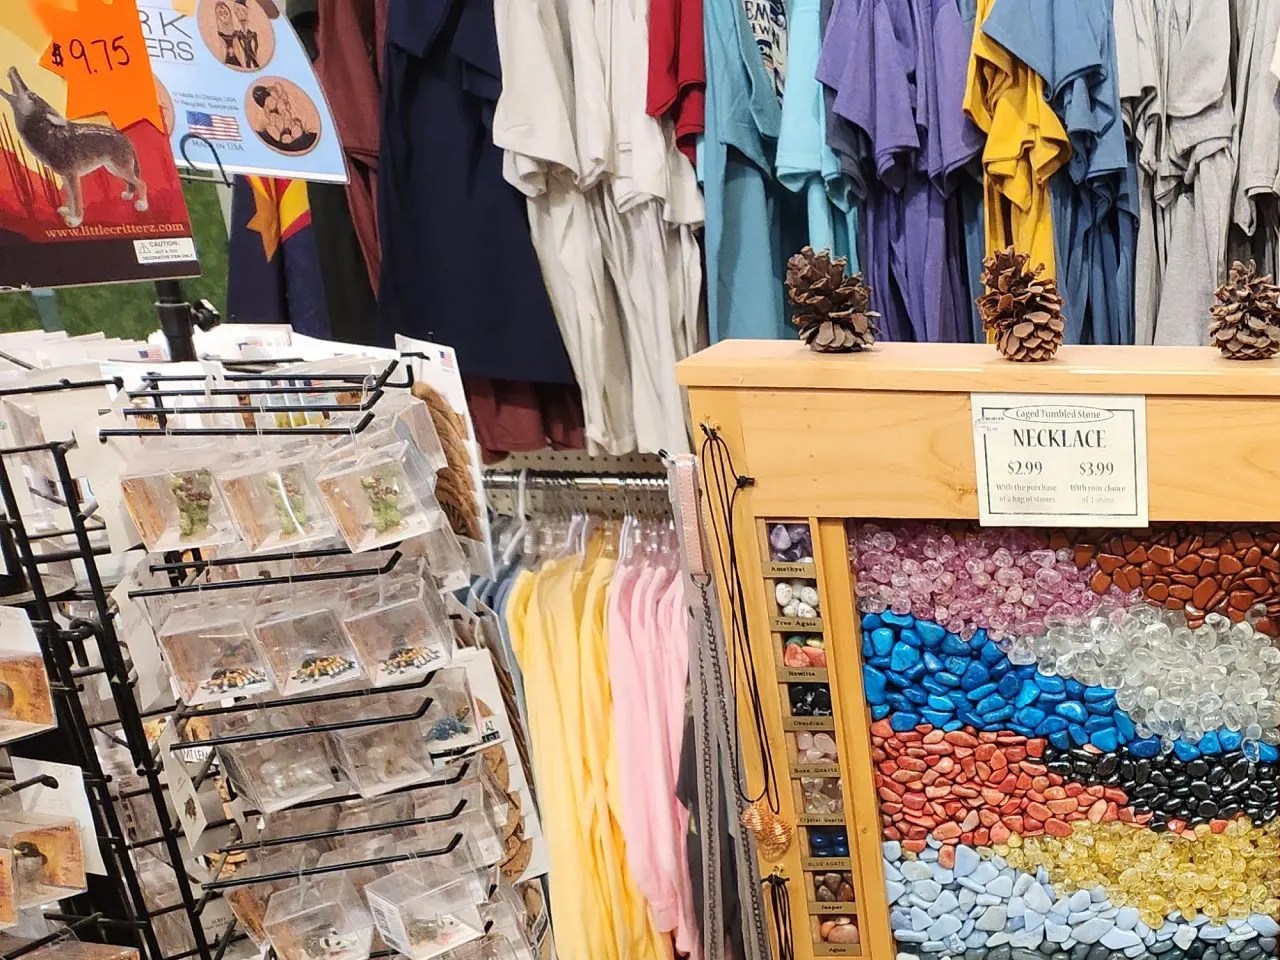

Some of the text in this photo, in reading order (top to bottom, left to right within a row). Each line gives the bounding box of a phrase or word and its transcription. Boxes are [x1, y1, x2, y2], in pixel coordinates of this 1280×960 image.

[51, 35, 130, 76] $9.75
[227, 143, 245, 152] USA
[44, 221, 185, 240] www.littlecritterz.com
[1016, 408, 1101, 419] Caged Tumbled Stone
[1013, 428, 1107, 448] NECKLACE
[1007, 460, 1043, 476] $2.99
[1079, 461, 1114, 476] $3.99
[996, 483, 1013, 491] With
[1026, 484, 1057, 493] purchase
[1070, 484, 1126, 494] With your choice
[1012, 494, 1025, 504] bag
